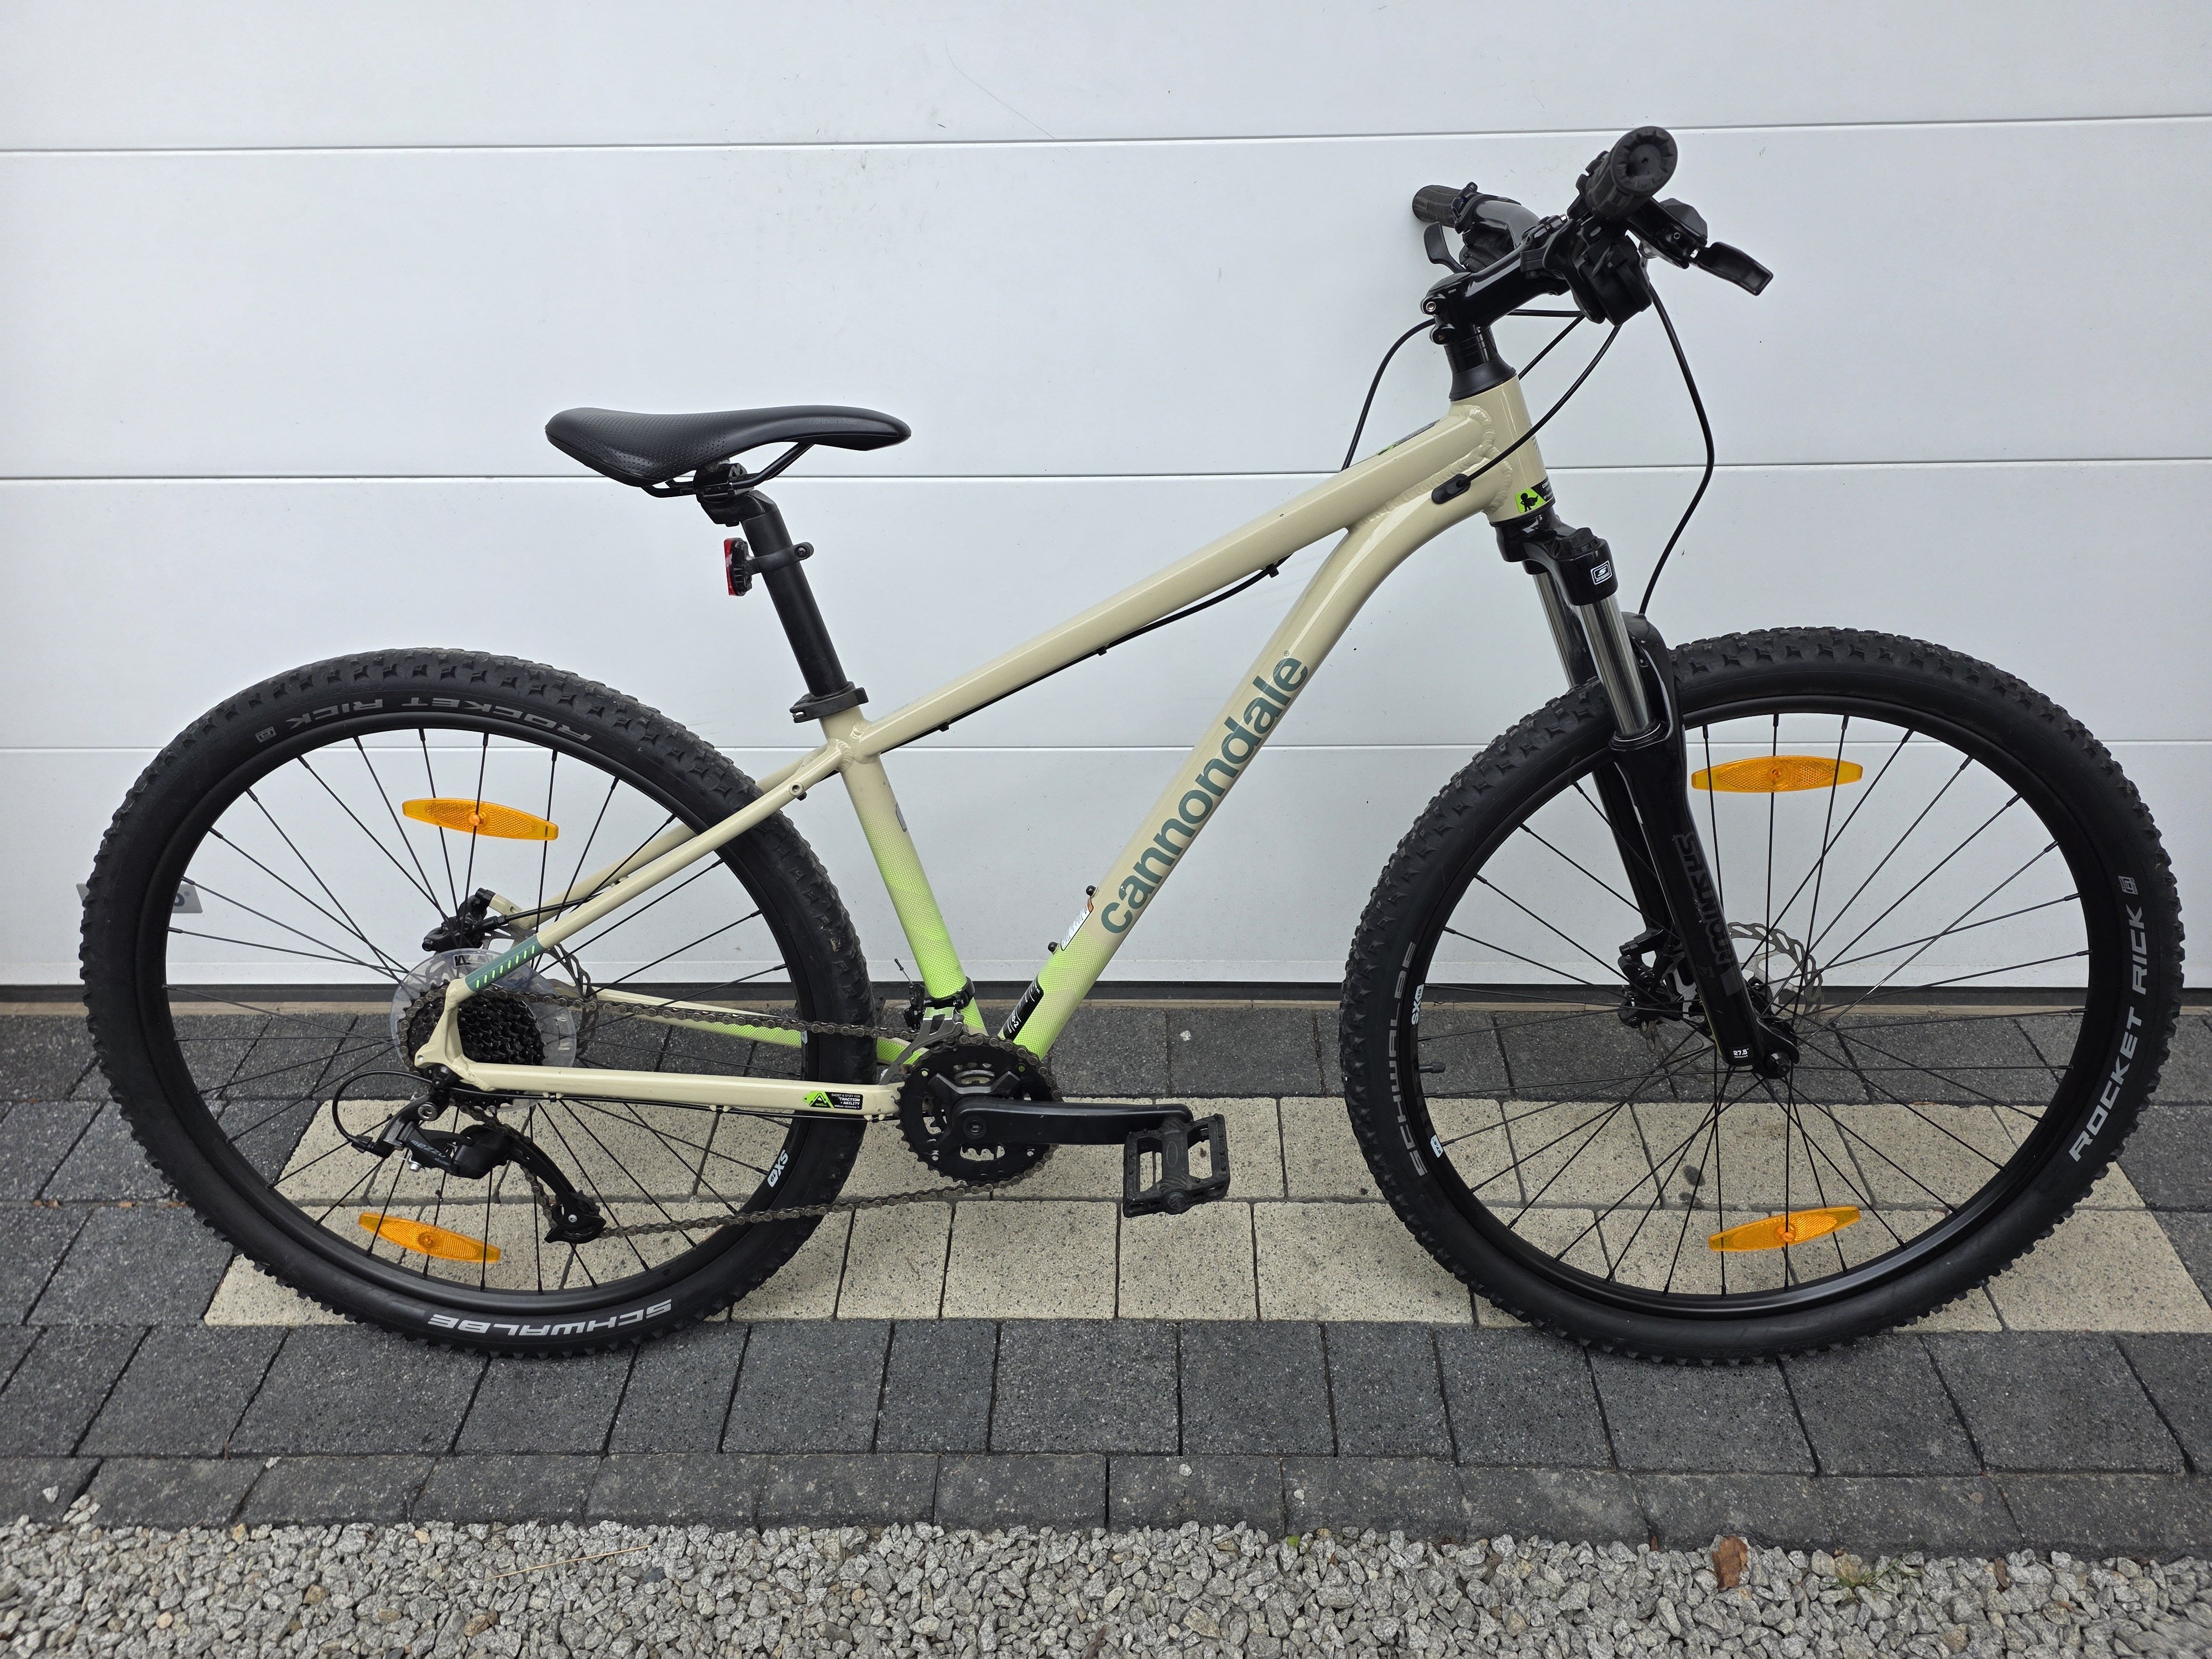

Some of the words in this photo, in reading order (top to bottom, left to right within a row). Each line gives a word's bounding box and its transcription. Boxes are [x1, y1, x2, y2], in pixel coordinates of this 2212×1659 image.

[285, 699, 383, 730] RICK
[401, 697, 592, 742] ROCKET
[1101, 657, 1308, 933] cannondale
[1389, 942, 1428, 1176] SCHWALBE
[2068, 1006, 2142, 1162] ROCKET
[2126, 904, 2147, 995] RICK
[427, 1298, 672, 1335] SCHWALBE
